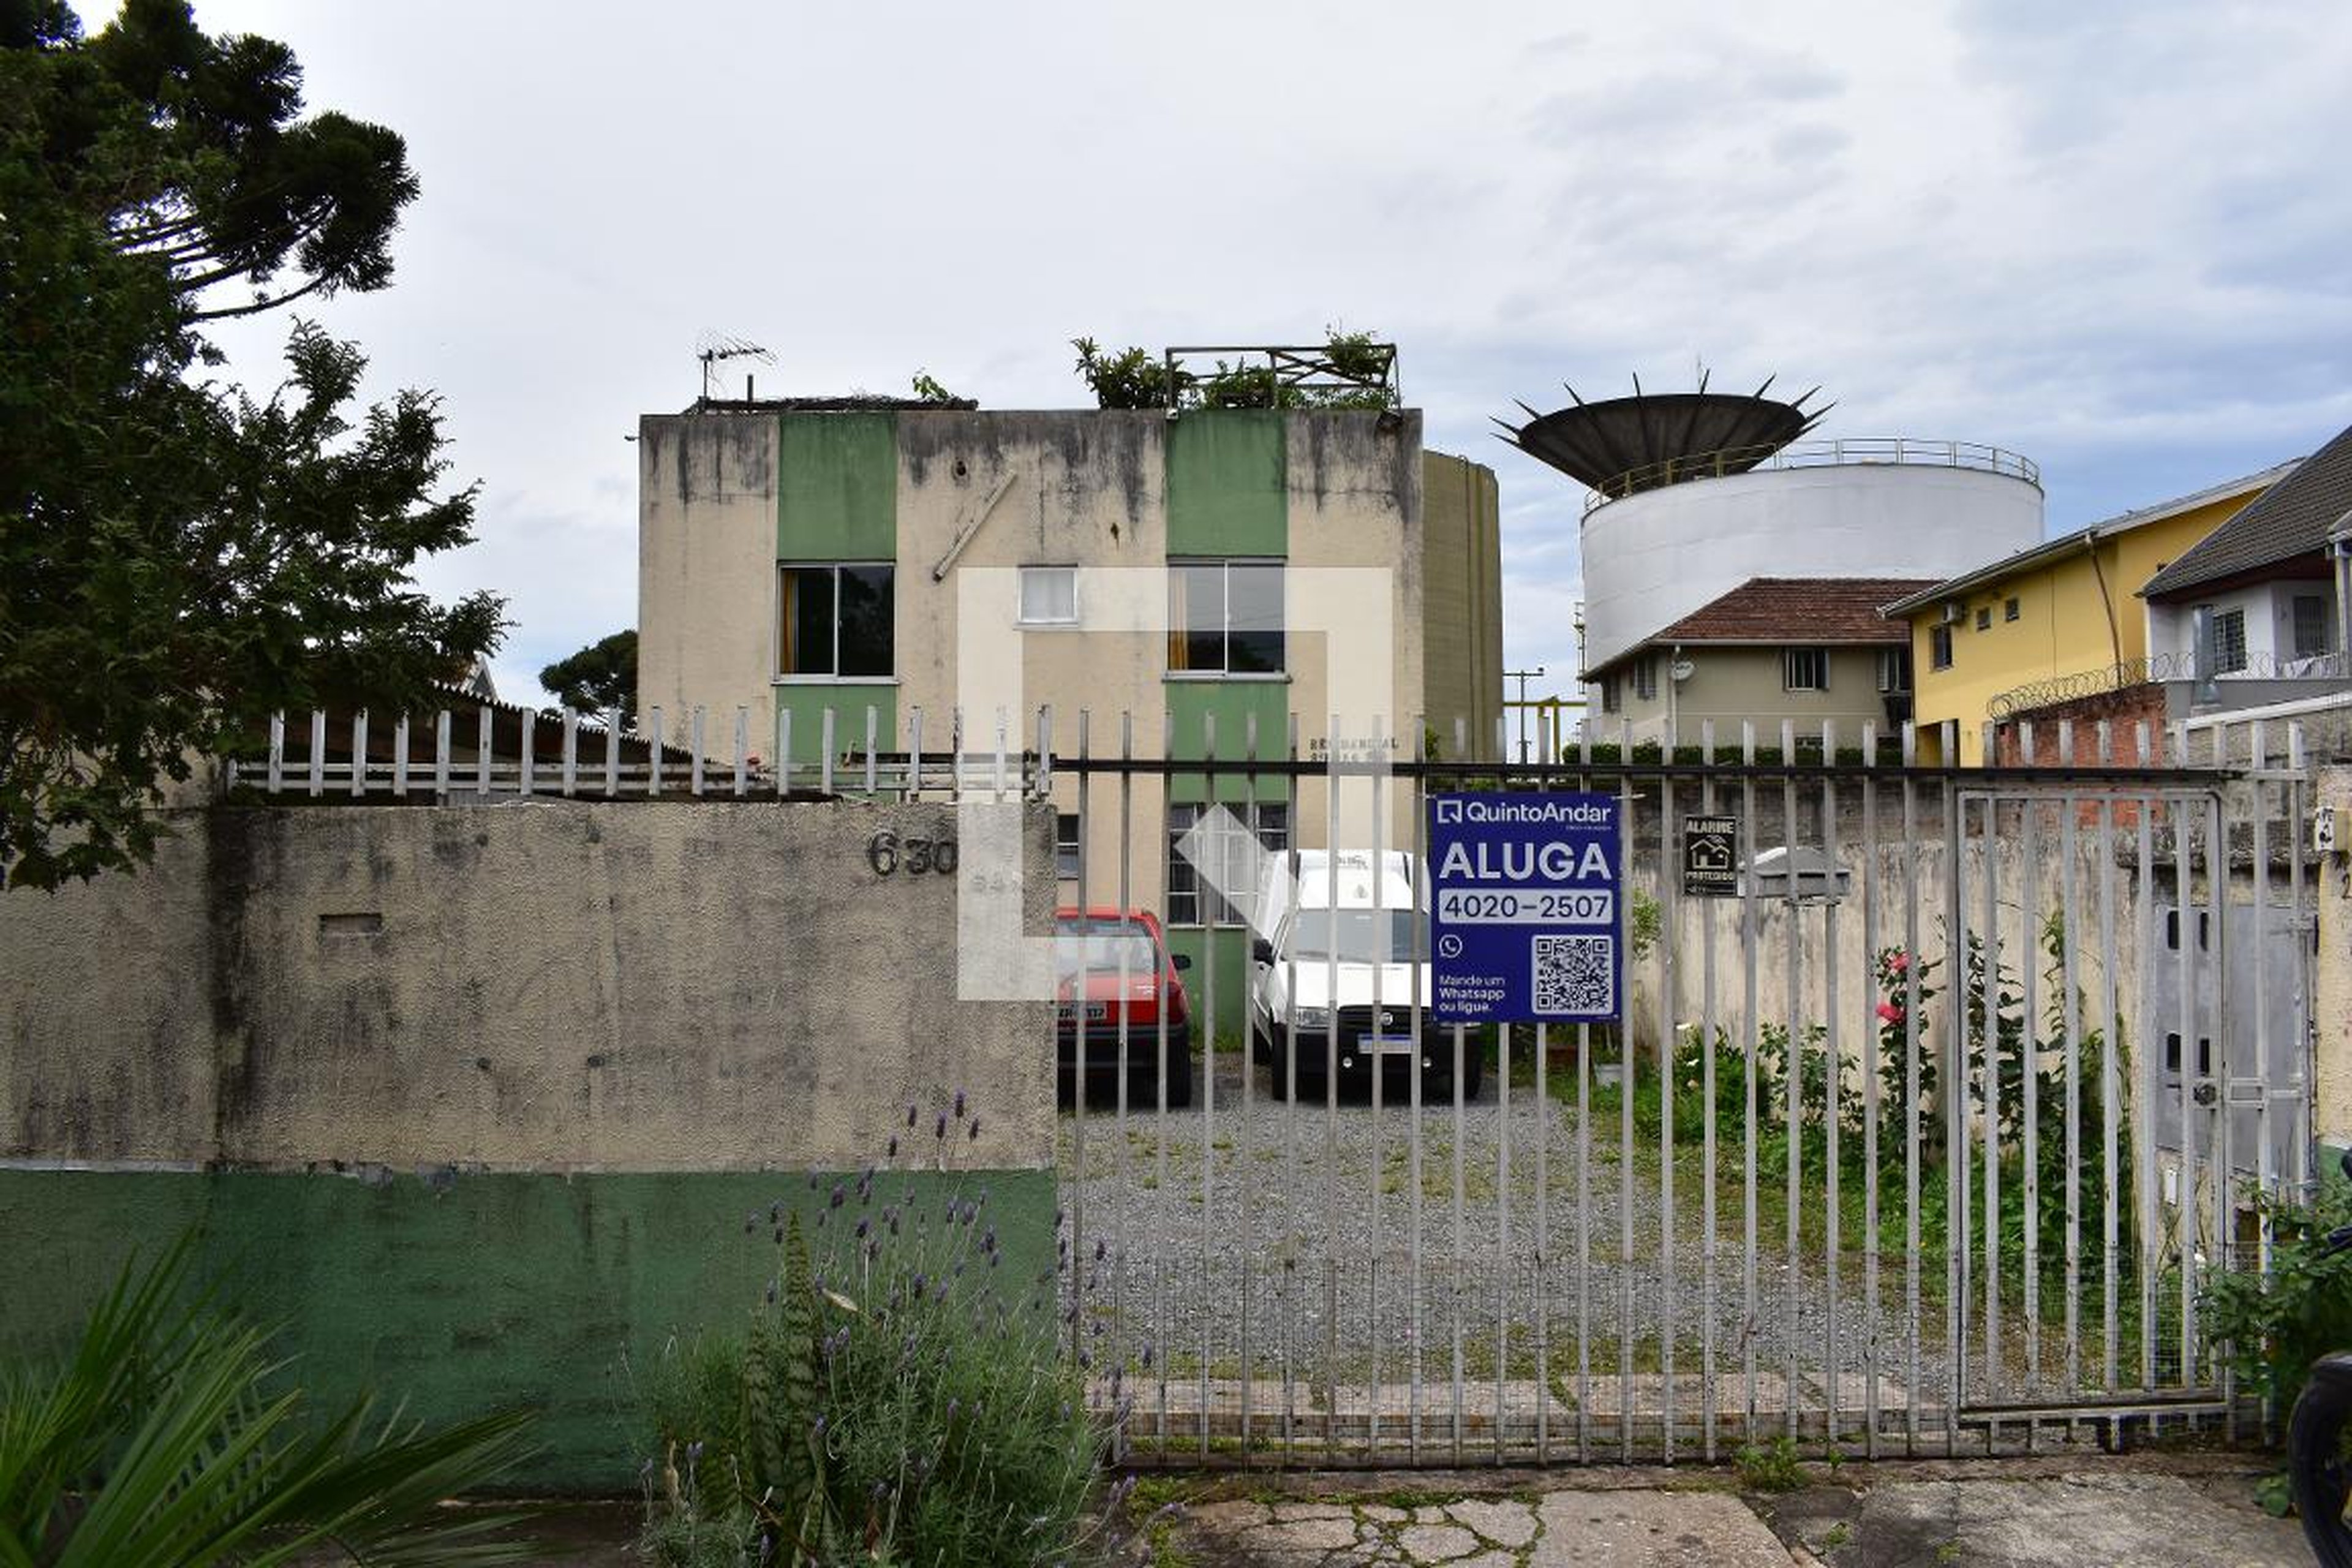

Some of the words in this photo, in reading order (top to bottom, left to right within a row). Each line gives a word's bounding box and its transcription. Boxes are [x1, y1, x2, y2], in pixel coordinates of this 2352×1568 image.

[1466, 802, 1611, 822] QuintoAndar
[866, 832, 959, 876] 630
[1439, 842, 1612, 881] ALUGA
[1444, 895, 1608, 918] 4020-2507
